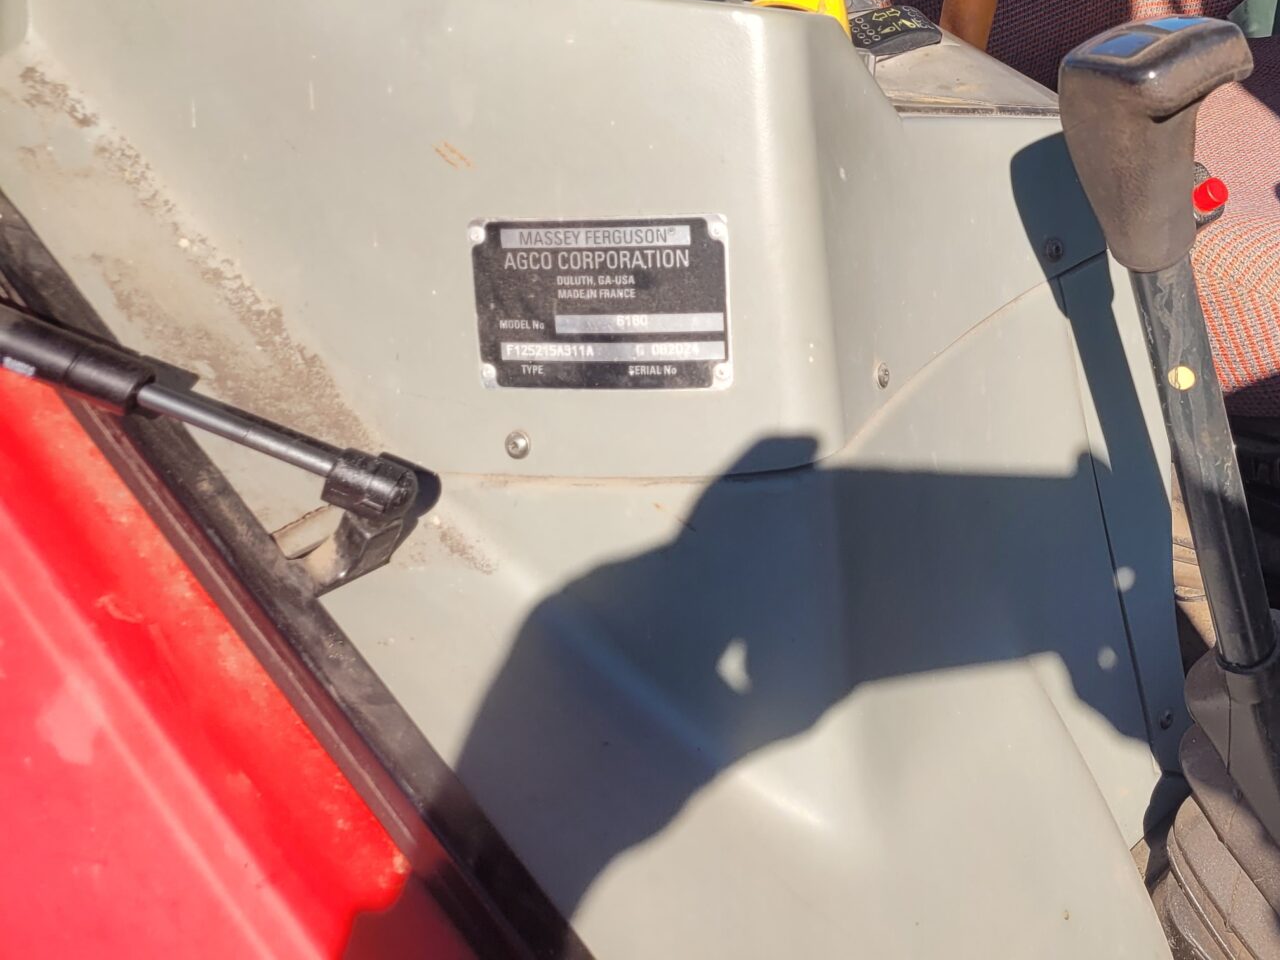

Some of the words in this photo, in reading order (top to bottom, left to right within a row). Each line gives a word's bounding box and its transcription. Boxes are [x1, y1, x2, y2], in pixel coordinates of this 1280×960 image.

[519, 231, 580, 246] MASSEY
[504, 251, 552, 270] AGCO
[557, 249, 690, 270] CORPORATION
[557, 289, 585, 299] MADE
[599, 288, 637, 299] FRANCE
[499, 320, 531, 330] MODEL
[521, 365, 544, 375] TYPE
[628, 365, 662, 376] SERIAL
